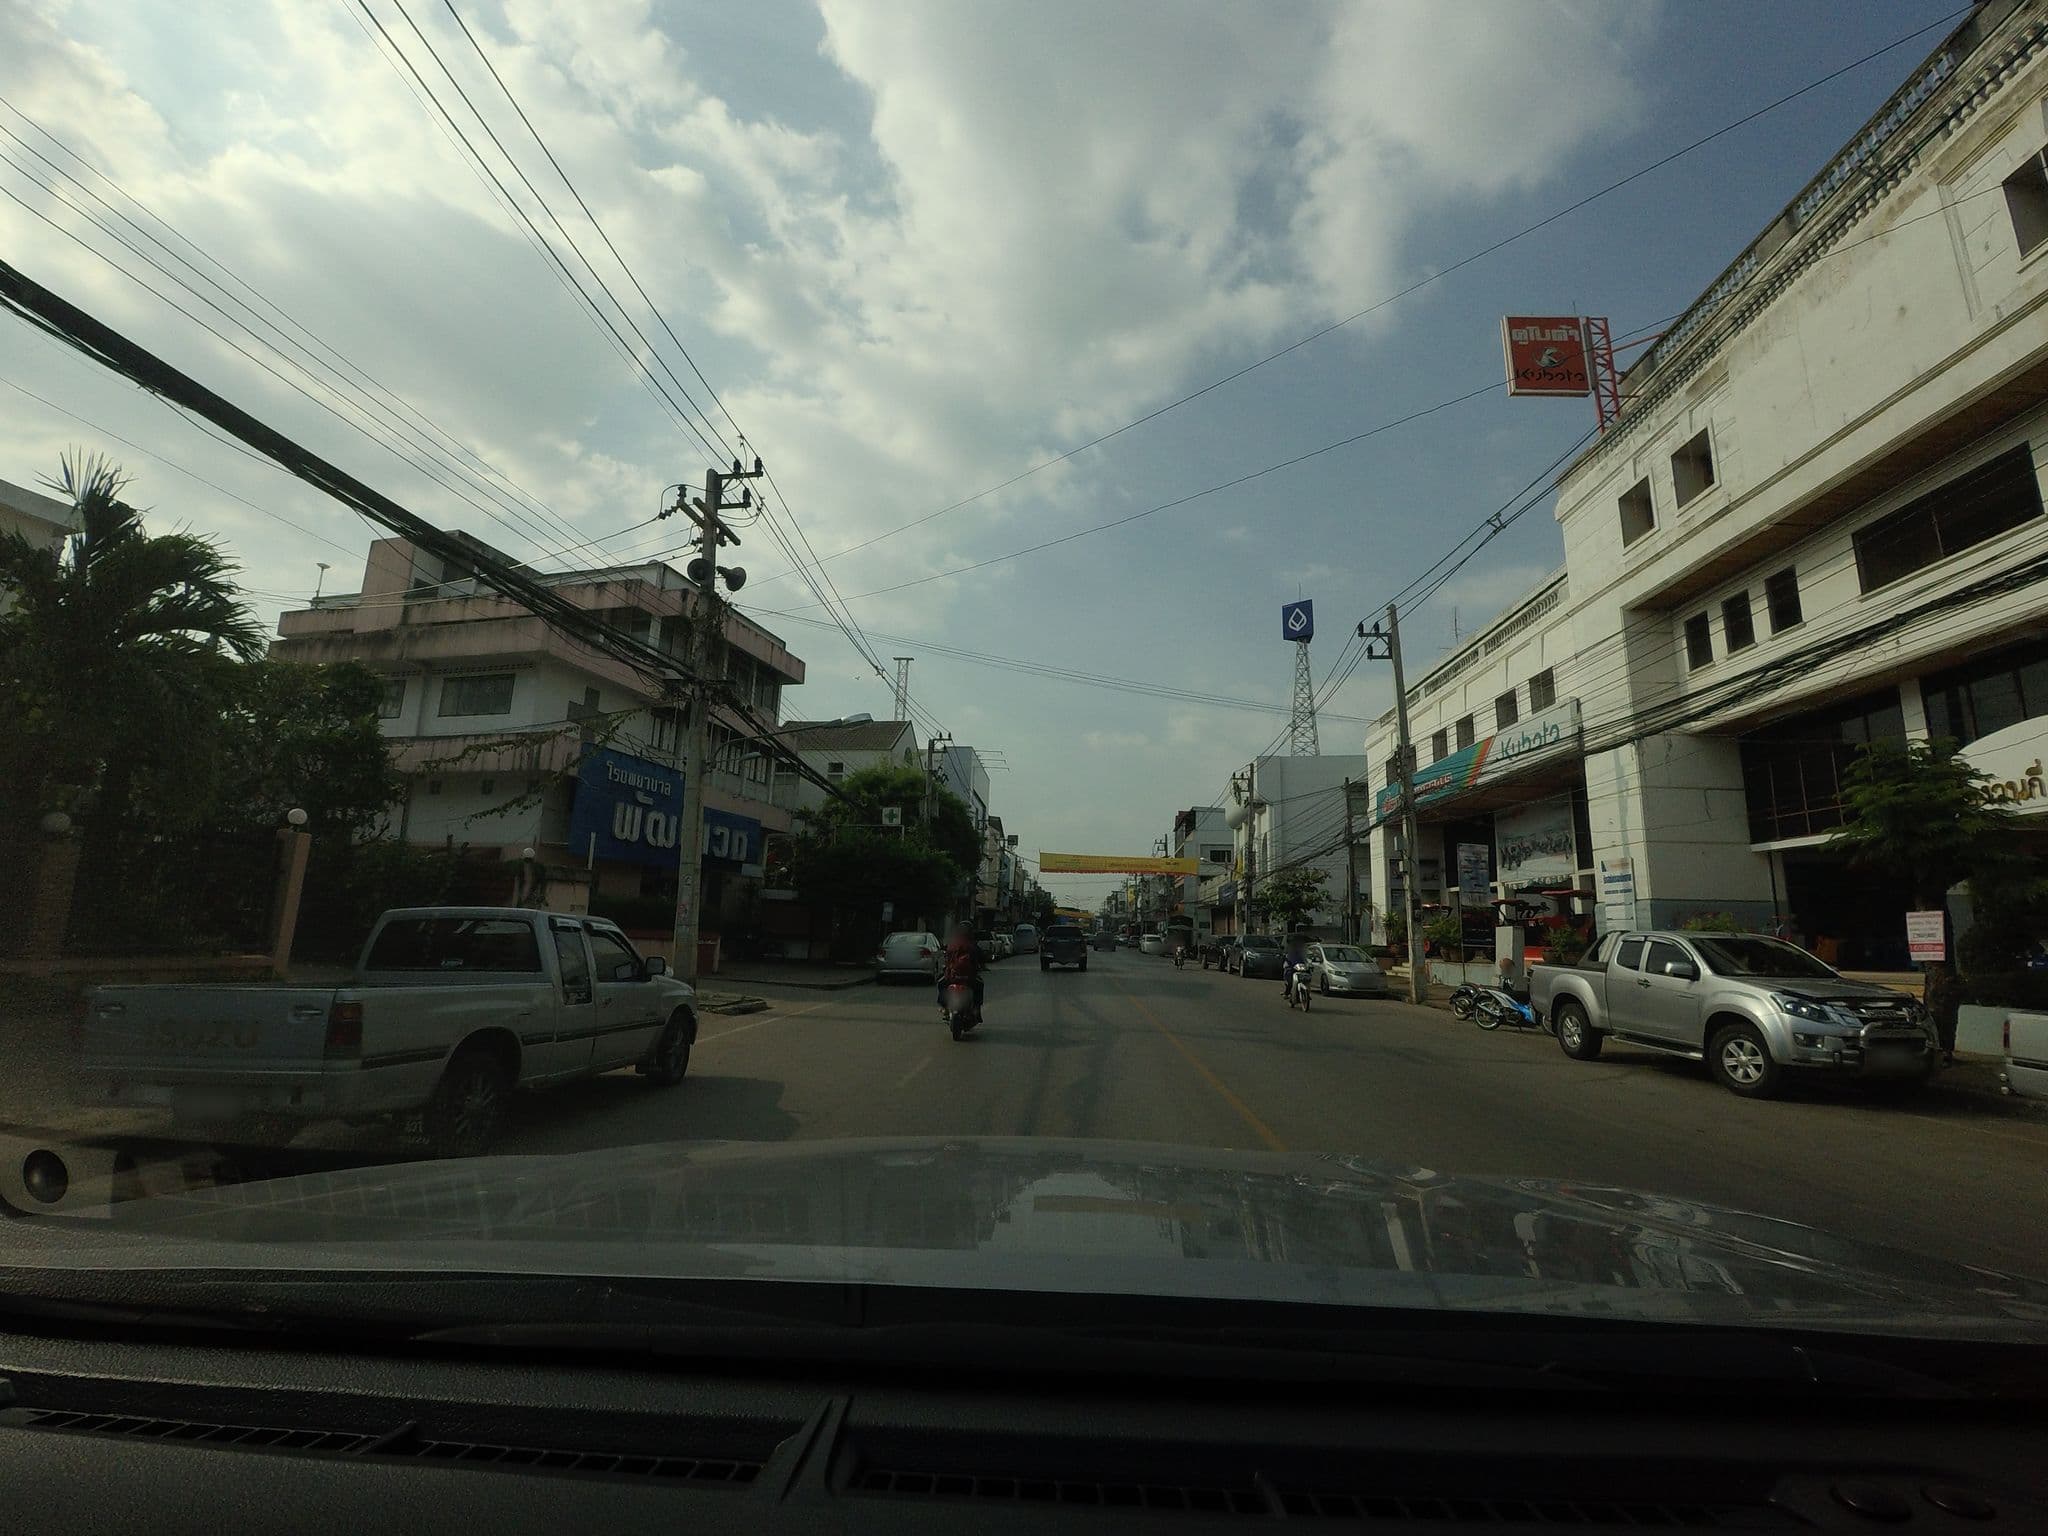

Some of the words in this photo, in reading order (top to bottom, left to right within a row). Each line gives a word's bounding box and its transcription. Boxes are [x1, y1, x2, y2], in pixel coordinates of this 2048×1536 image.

[1514, 367, 1585, 384] Kubota
[606, 760, 672, 797] โรงพยาบาล
